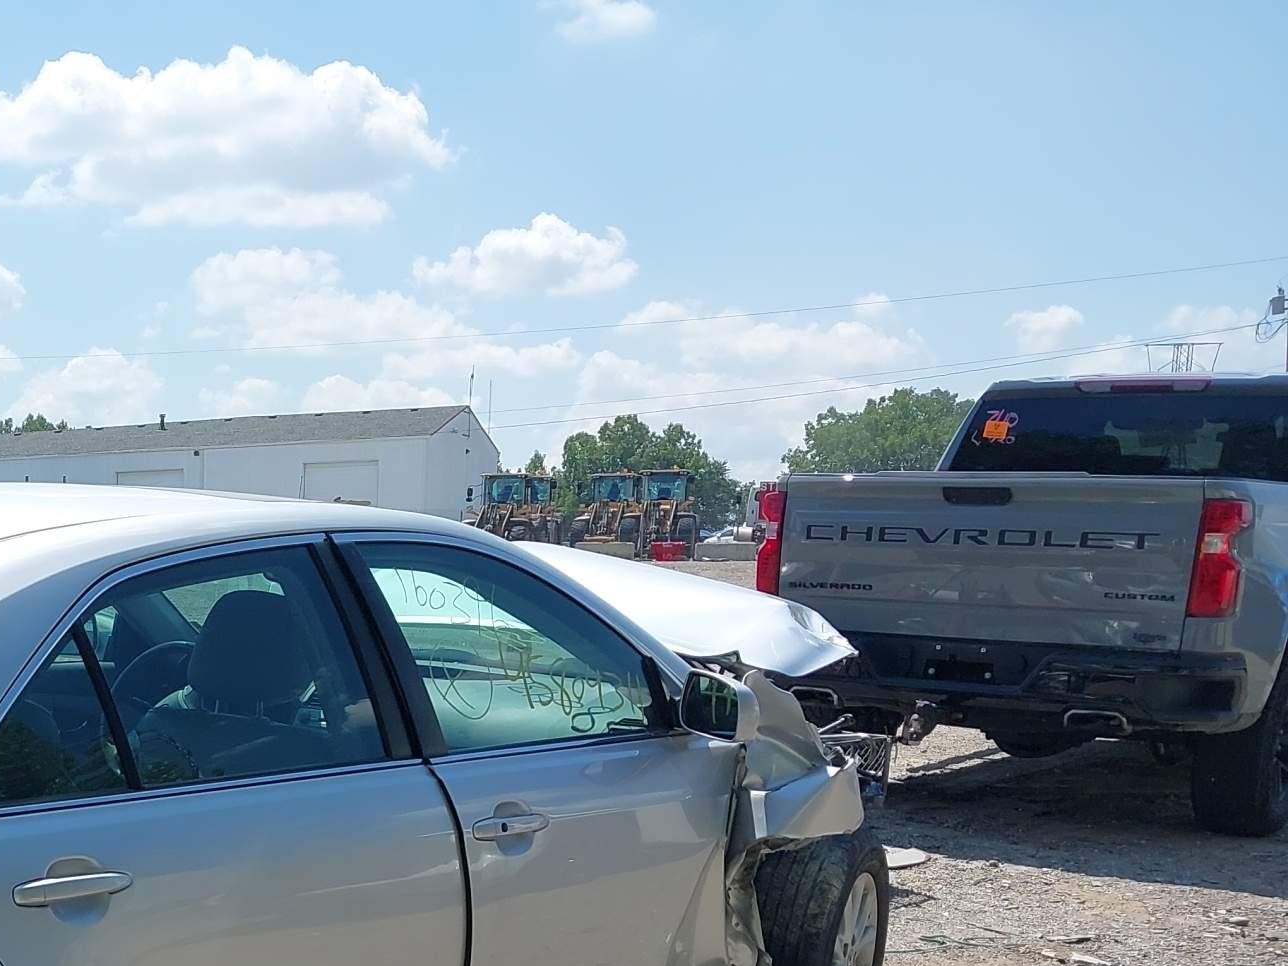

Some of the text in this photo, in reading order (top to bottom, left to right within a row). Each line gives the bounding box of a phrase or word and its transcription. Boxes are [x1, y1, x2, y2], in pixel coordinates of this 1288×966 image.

[806, 525, 1161, 550] CHEVROLET
[788, 581, 873, 592] SILVERADO
[1103, 592, 1175, 602] CUSTOM
